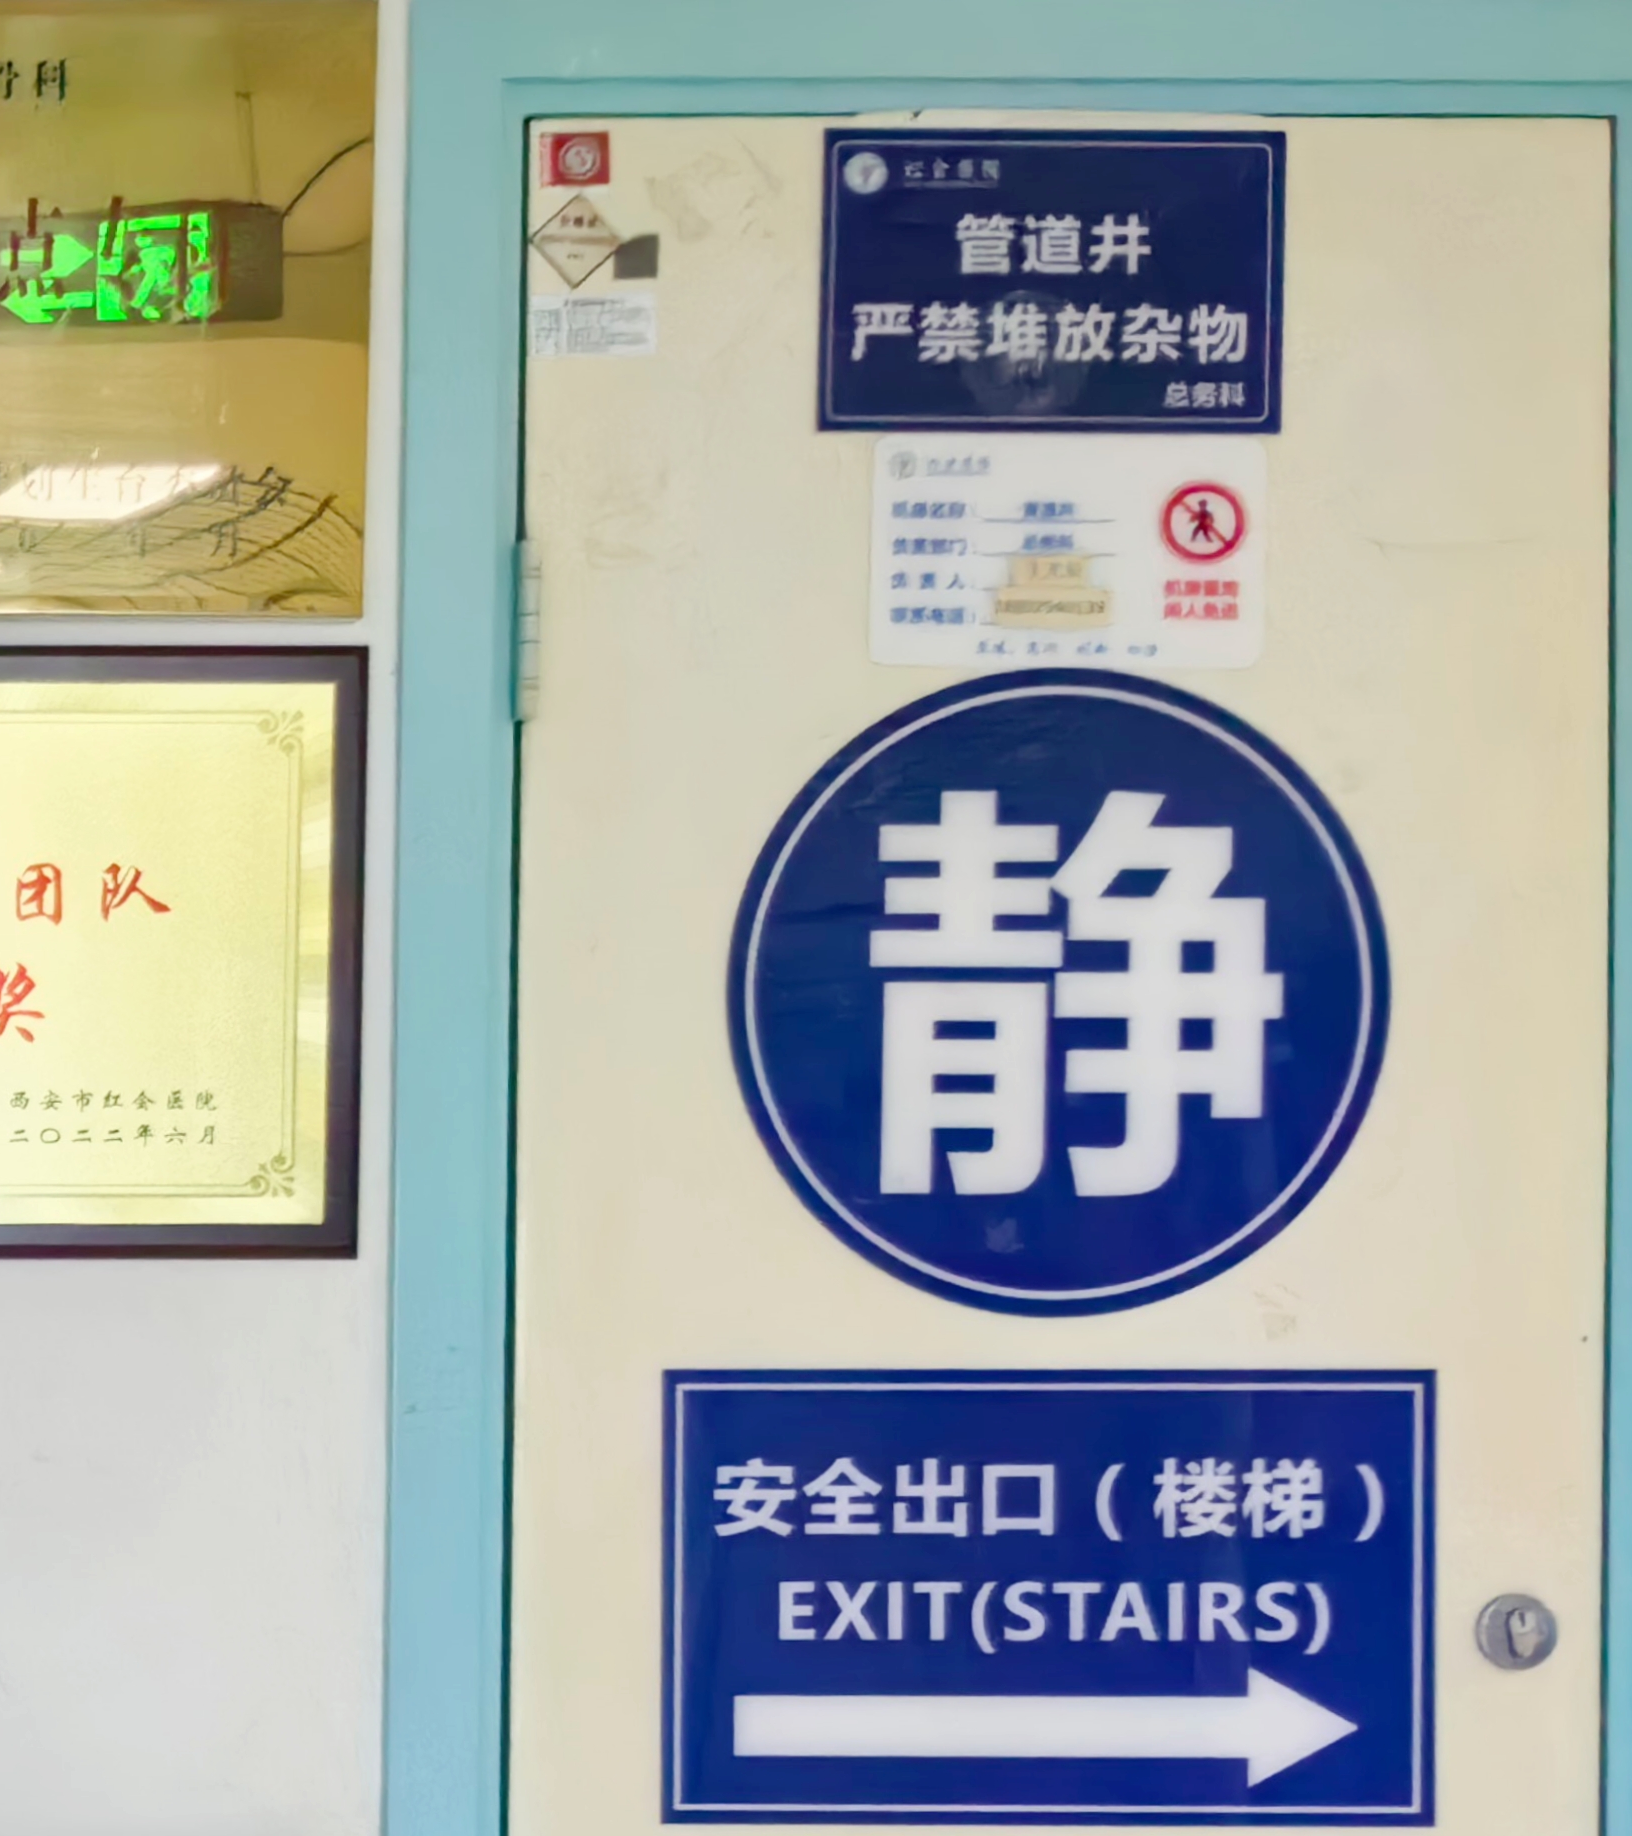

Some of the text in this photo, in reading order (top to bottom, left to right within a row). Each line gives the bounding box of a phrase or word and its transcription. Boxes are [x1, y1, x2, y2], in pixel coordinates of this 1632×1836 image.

[955, 213, 1152, 275] 管道井
[850, 301, 1249, 364] 严禁堆放杂物
[869, 790, 1284, 1197] 静
[9, 1088, 218, 1113] 西安市红会医院
[712, 1457, 1385, 1542] 安全出口（楼梯）
[777, 1580, 1332, 1655] EXIT(STAIRS)
